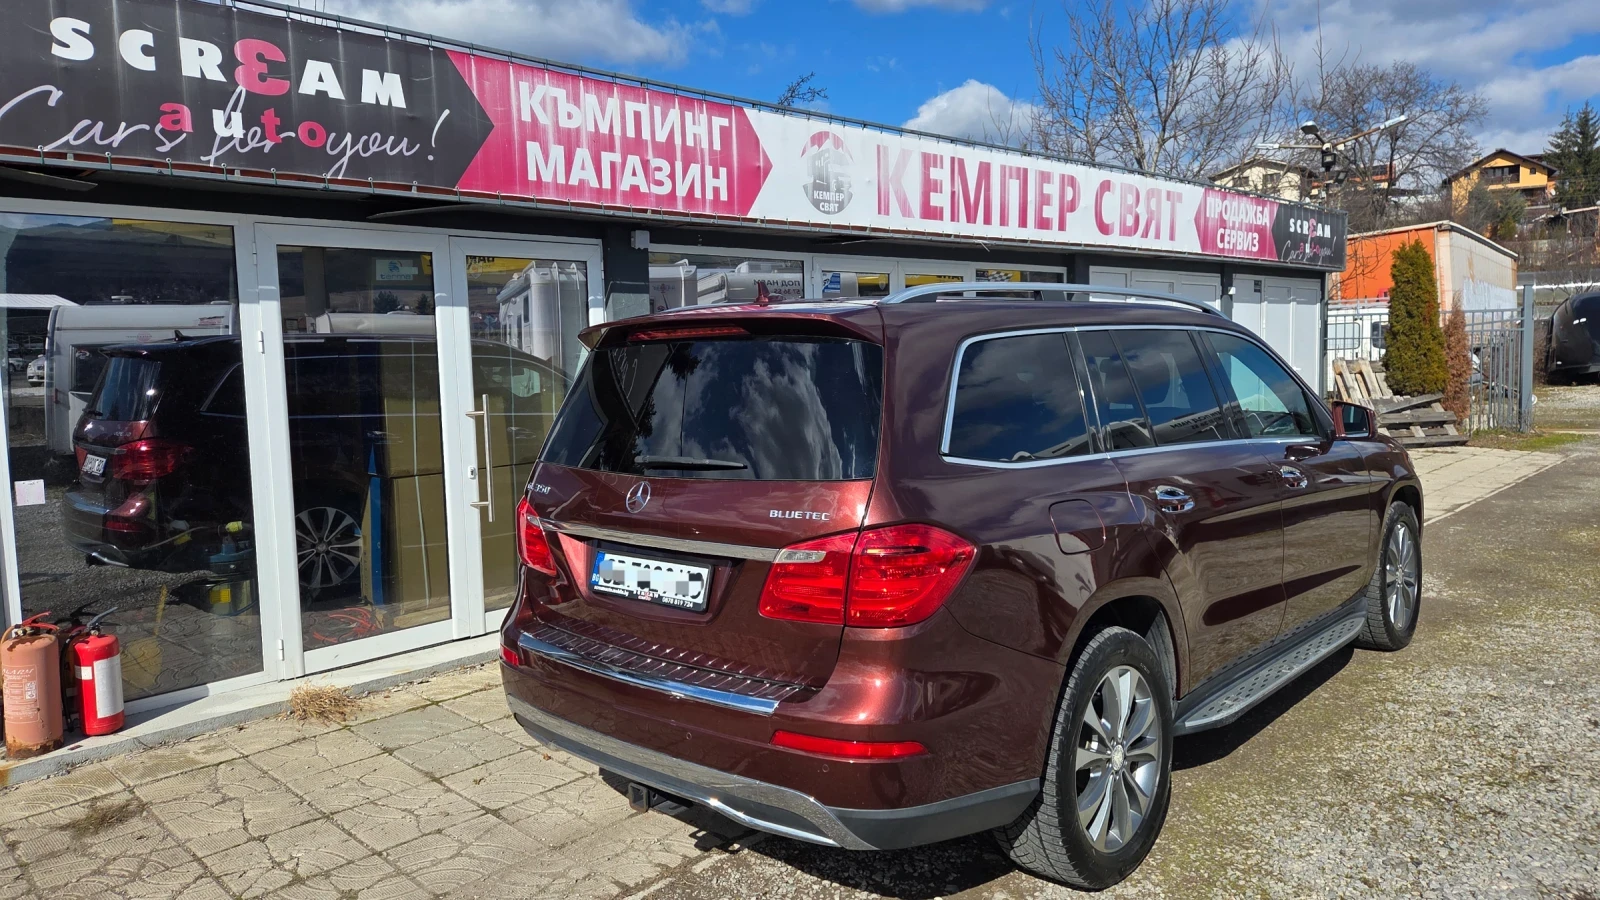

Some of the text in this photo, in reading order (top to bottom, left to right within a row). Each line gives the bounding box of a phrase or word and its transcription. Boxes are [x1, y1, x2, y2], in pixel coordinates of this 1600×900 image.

[49, 16, 407, 108] SCREAM
[159, 102, 327, 148] auto
[519, 80, 729, 151] КЪМПИНГ
[0, 84, 186, 153] Cars
[325, 108, 450, 179] you!
[527, 140, 728, 202] МАГАЗИН
[813, 190, 845, 202] КЕМПЕР
[876, 143, 1183, 242] КЕМПЕР СВЯТ
[819, 202, 839, 211] СВЯТ
[1206, 197, 1270, 228] ПРОДАЖБА
[1216, 228, 1259, 252] СЕРВИЗ
[1289, 218, 1331, 238] SCREAM
[1299, 242, 1320, 255] auto
[769, 509, 831, 521] BLUETEC
[592, 572, 600, 582] BG
